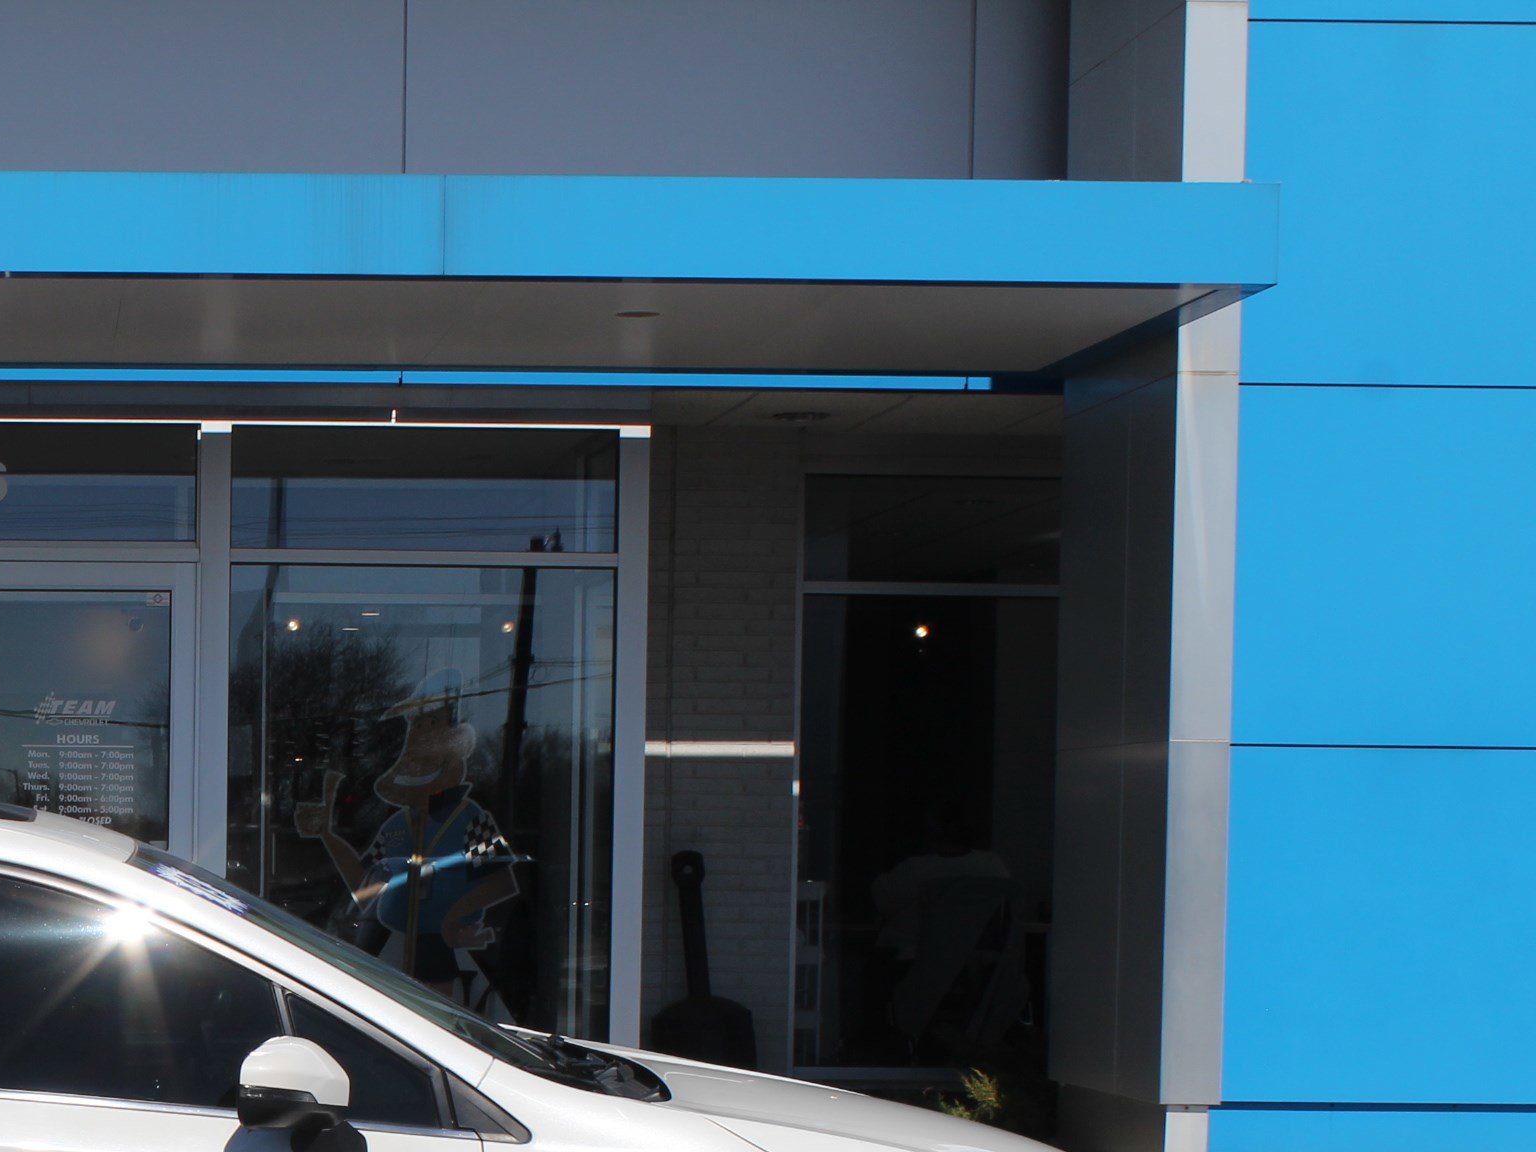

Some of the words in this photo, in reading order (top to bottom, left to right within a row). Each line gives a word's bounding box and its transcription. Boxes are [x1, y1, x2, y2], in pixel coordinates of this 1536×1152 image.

[50, 700, 117, 715] TEAM
[64, 718, 109, 726] CHEVROLET
[56, 734, 100, 745] HOURS
[27, 750, 50, 758] Mon.
[59, 751, 92, 759] 9:00am
[101, 751, 134, 761] 7:00pm
[27, 761, 50, 769] Tues.
[59, 762, 92, 770] 9:00am
[101, 763, 134, 771] 7:00pm
[27, 772, 50, 780] Wed.
[101, 773, 134, 782] 7:00pm
[23, 783, 50, 791] Thurs.
[101, 784, 134, 793] 7:00pm
[35, 794, 50, 802] Fri.
[59, 794, 92, 802] 9:00am
[59, 805, 92, 814] 9:00am
